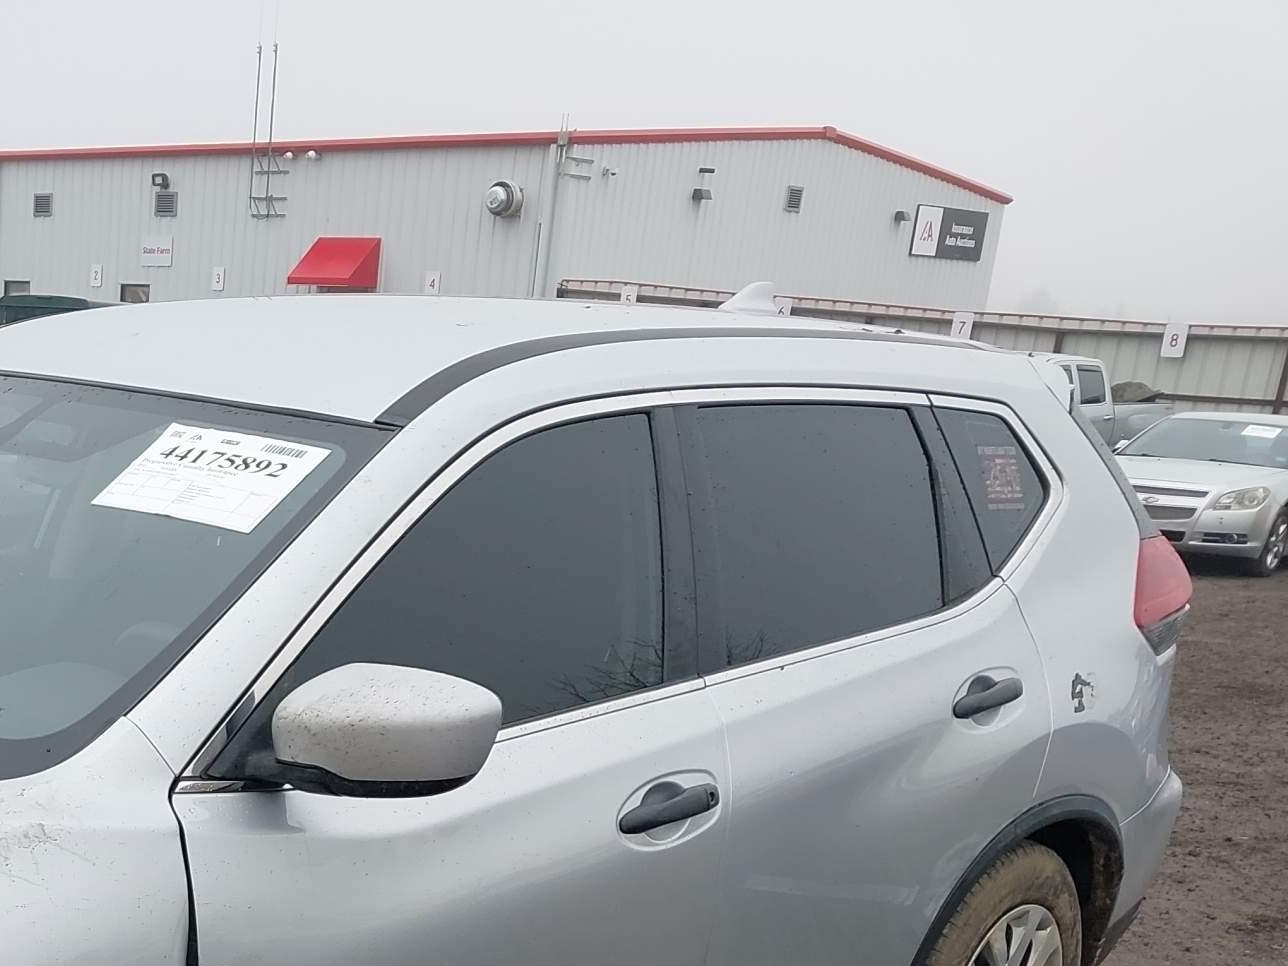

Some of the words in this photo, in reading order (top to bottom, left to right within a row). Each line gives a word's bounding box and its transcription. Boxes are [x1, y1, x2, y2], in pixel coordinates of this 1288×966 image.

[429, 278, 435, 289] 4
[958, 321, 967, 334] 7
[1169, 333, 1179, 347] 8
[159, 444, 289, 478] 44175892
